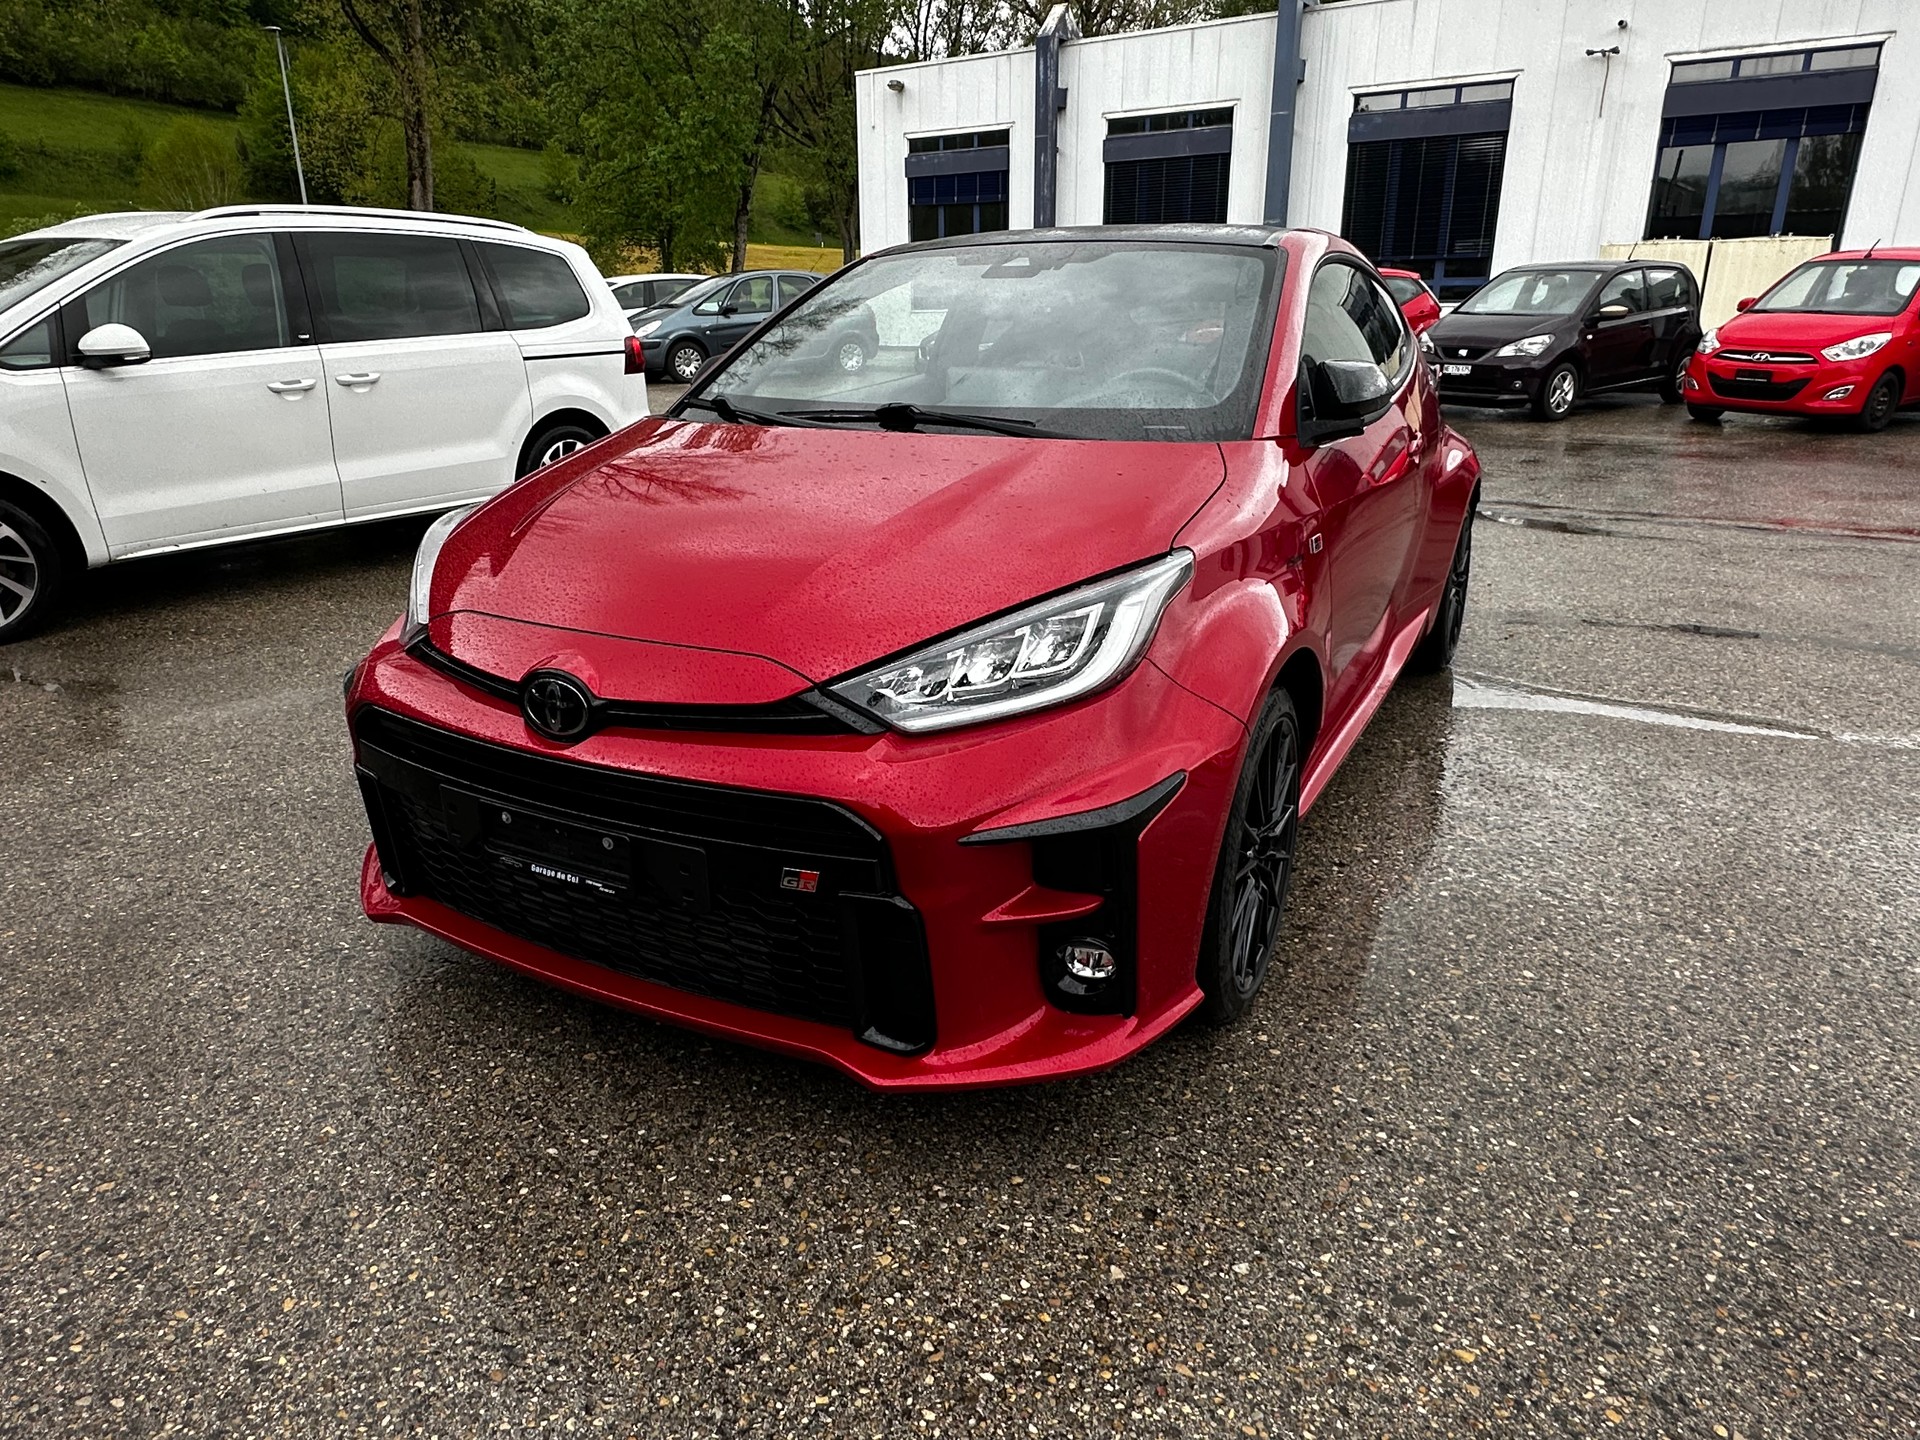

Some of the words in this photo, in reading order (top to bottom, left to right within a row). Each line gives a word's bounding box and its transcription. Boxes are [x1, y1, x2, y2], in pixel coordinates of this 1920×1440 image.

[531, 864, 556, 877] Garage
[566, 874, 579, 884] Col
[782, 876, 816, 891] GR
